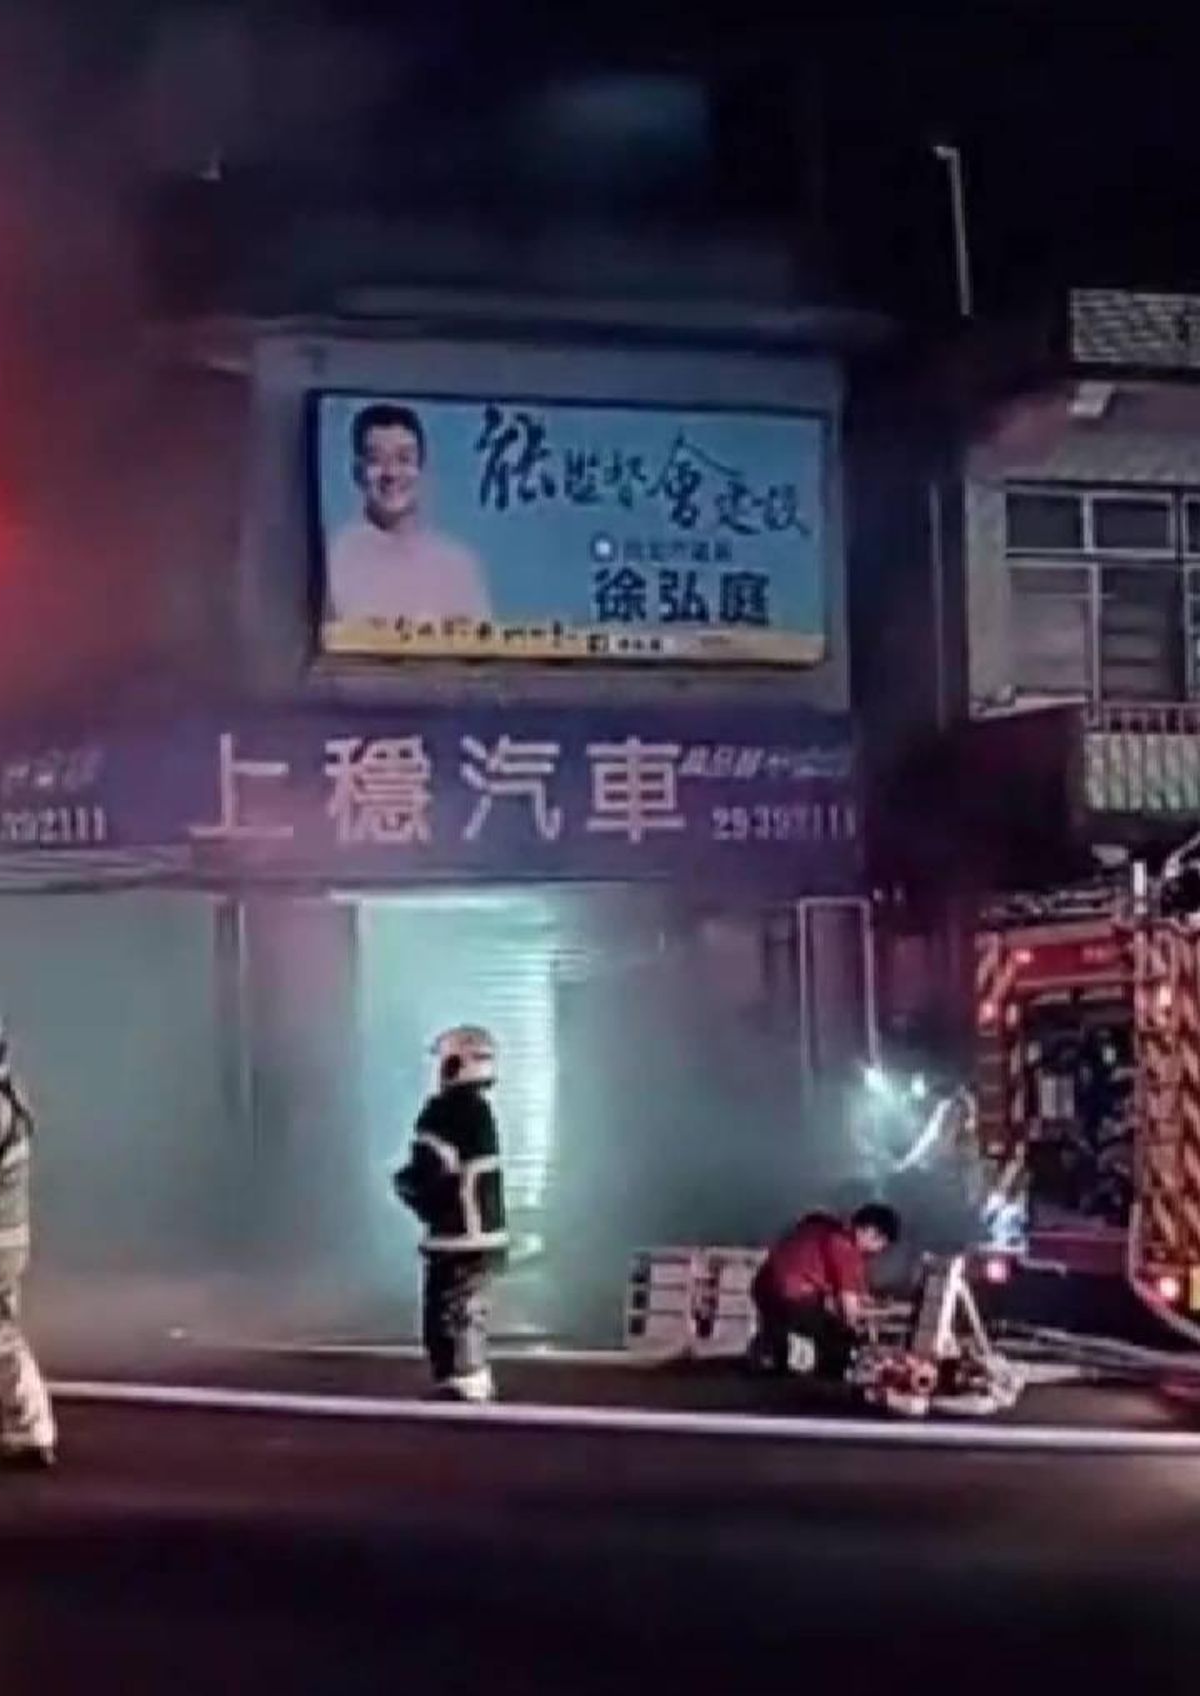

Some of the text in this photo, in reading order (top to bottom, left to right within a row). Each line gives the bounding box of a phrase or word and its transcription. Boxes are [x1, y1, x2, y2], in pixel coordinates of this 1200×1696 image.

[594, 566, 770, 627] 徐弘庭
[189, 733, 686, 844] 上穩汽車
